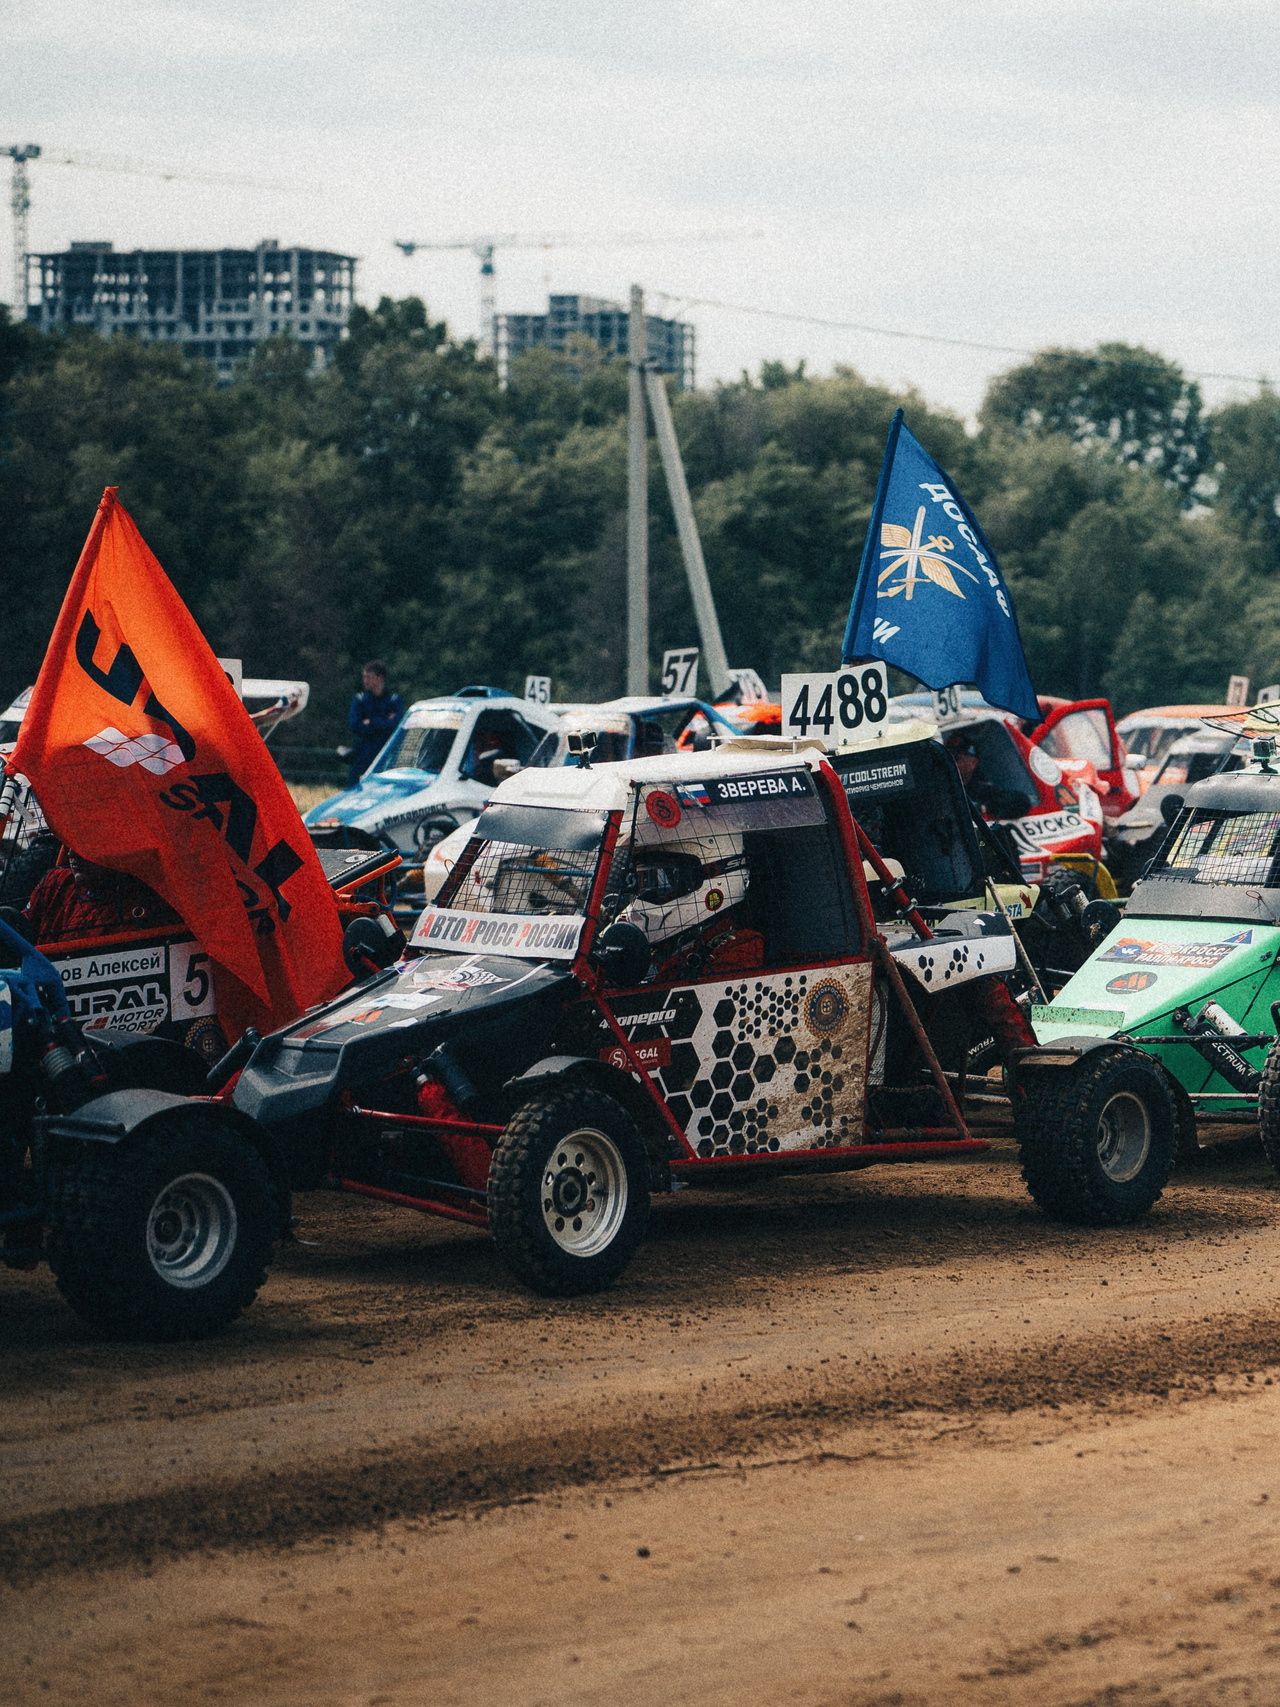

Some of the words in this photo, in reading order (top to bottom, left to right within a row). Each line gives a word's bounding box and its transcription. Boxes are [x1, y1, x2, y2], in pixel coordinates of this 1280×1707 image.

[661, 653, 699, 695] 57
[528, 680, 548, 704] 45
[836, 668, 888, 729] 88
[788, 683, 835, 736] 44
[849, 763, 907, 784] COOLSTREAM
[717, 777, 788, 799] ЗВЕРЕВА
[791, 776, 807, 792] А.
[844, 784, 870, 795] НТИФРИЗ
[418, 913, 519, 948] АВТОКРОСС
[515, 921, 581, 950] РОССИИ
[87, 951, 160, 979] Алексей
[109, 1008, 165, 1025] MOTOR
